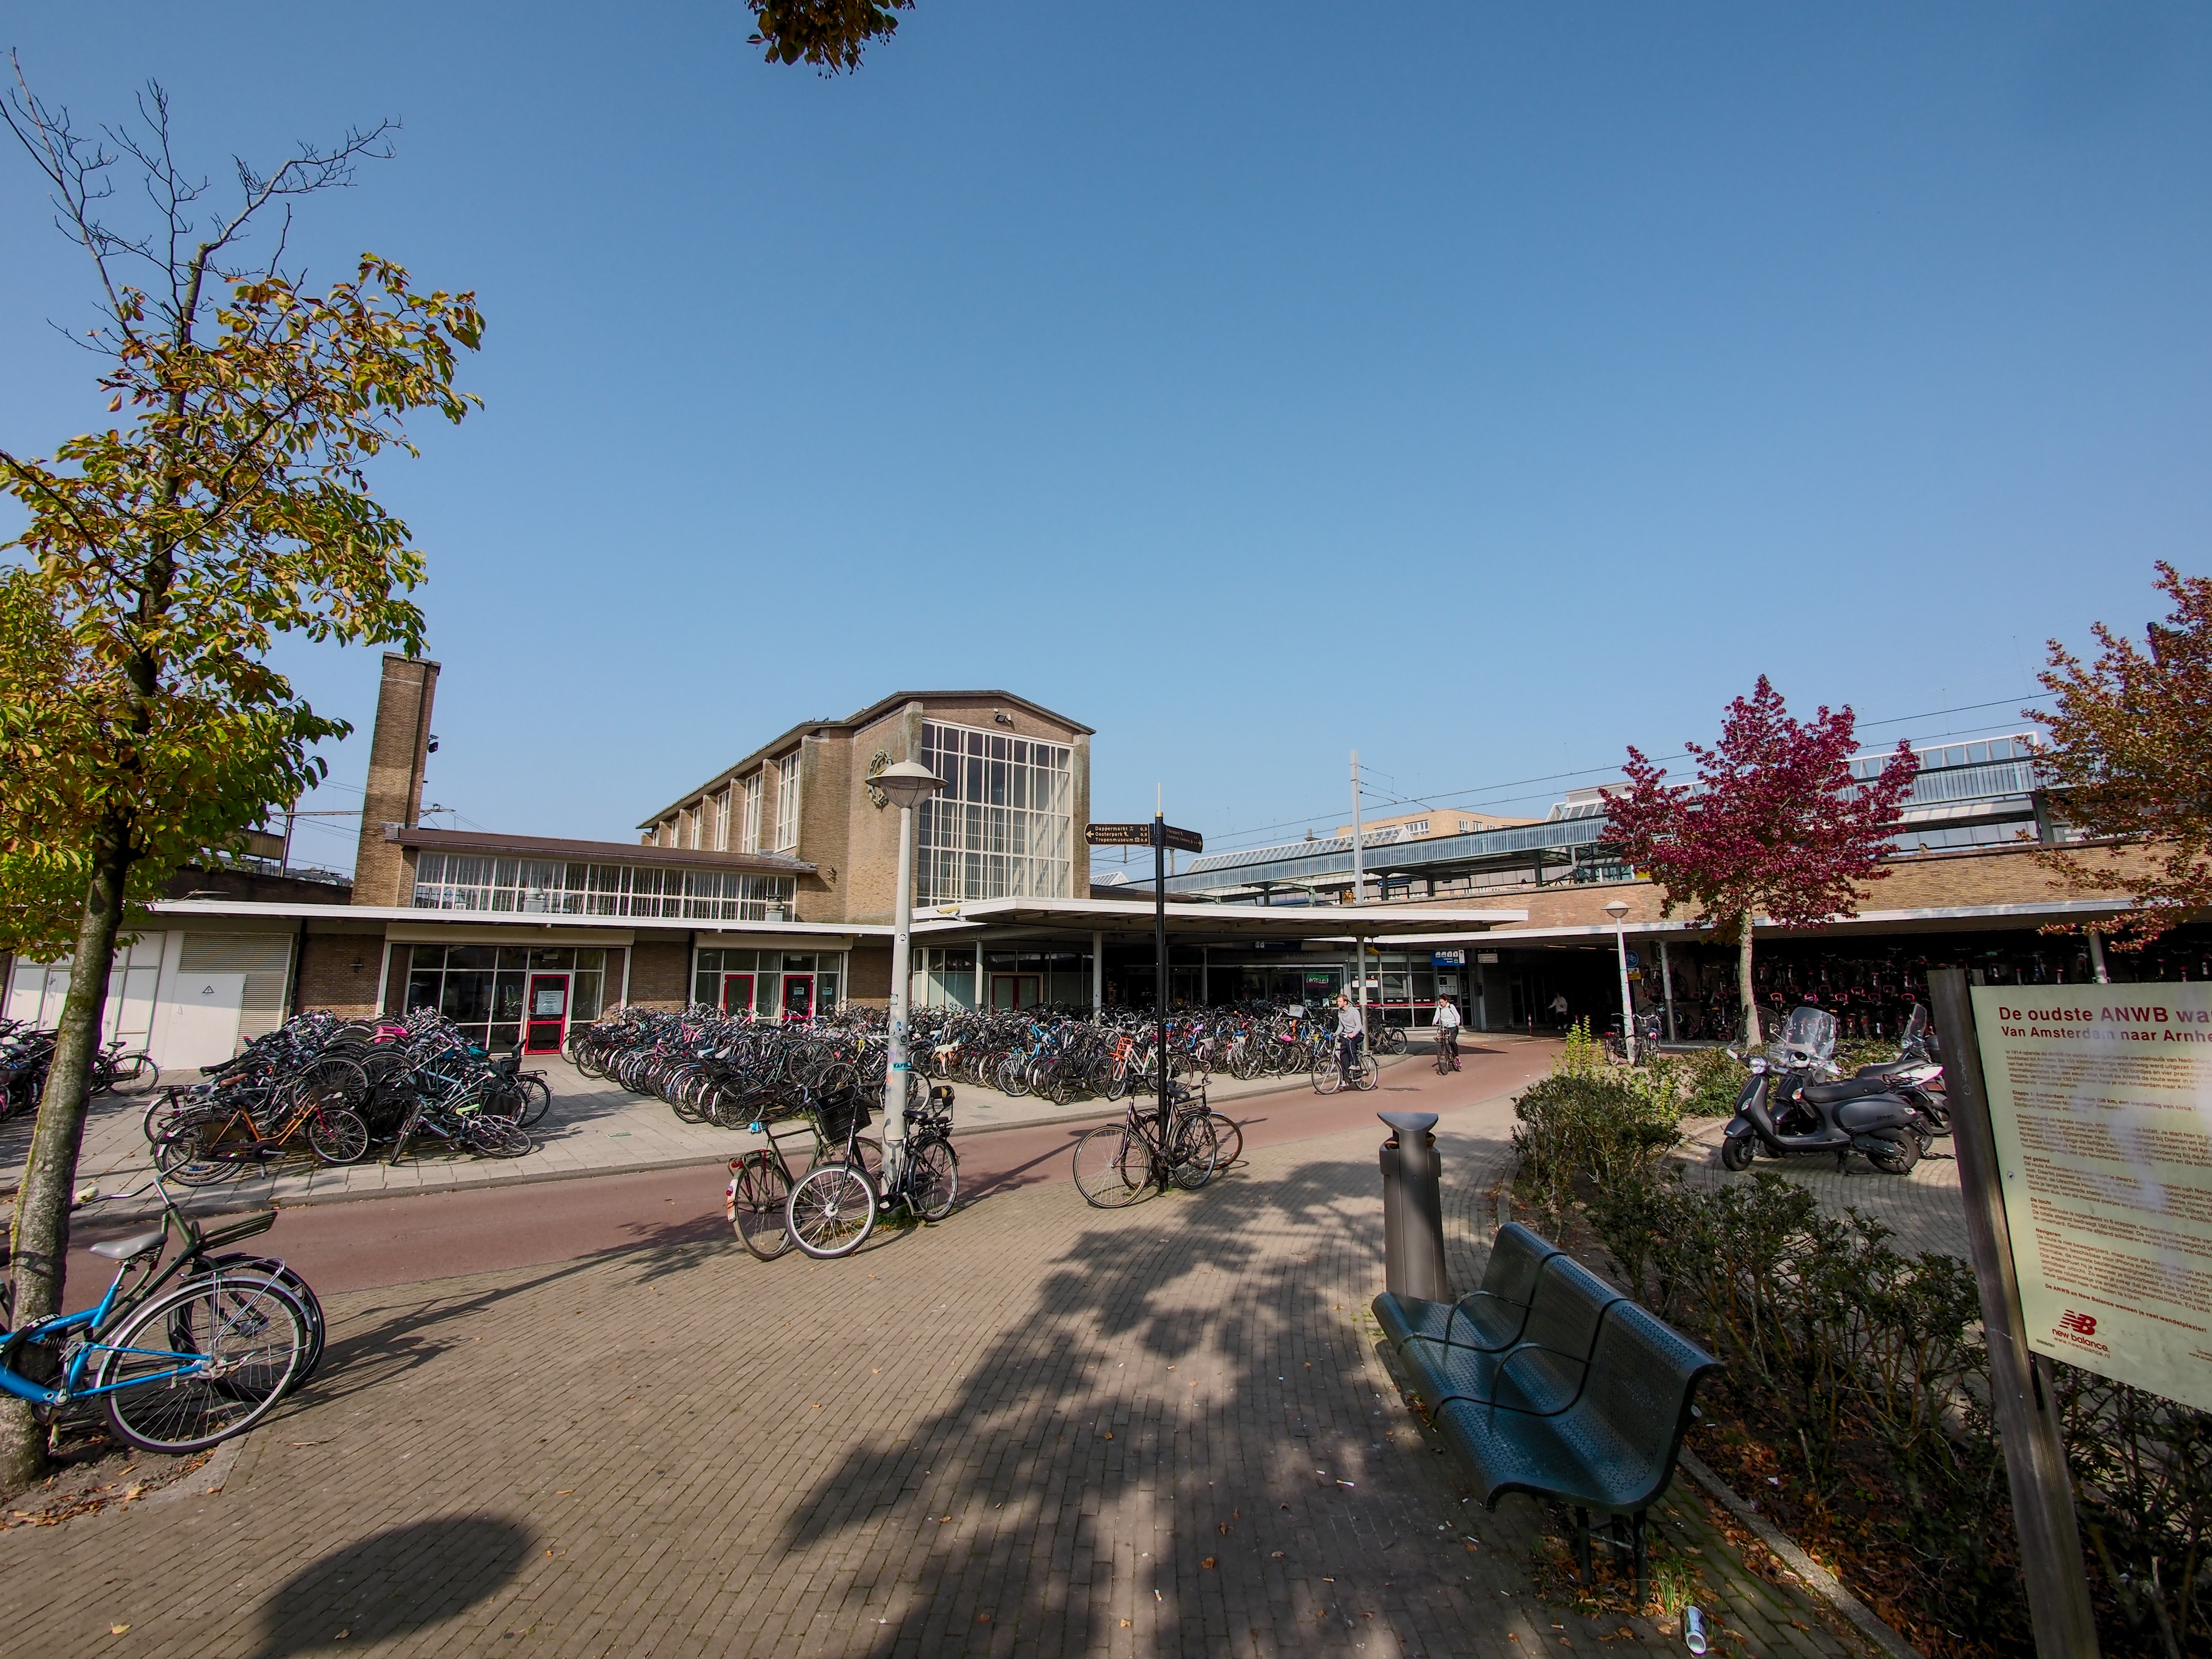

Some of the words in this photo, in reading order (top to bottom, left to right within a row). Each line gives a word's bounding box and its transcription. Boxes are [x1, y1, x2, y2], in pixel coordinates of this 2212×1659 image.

[1998, 1007, 2022, 1020] De
[2027, 1007, 2093, 1021] oudste
[2099, 1007, 2169, 1022] ANWB
[2175, 1010, 2212, 1022] wa
[2000, 1025, 2026, 1037] Van
[2029, 1026, 2115, 1039] Amsterdam
[2120, 1031, 2157, 1041] naar
[2035, 1227, 2061, 1237] Navigeren
[2074, 1213, 2102, 1222] opgedeeld
[2181, 1234, 2201, 1242] lengte
[2069, 1248, 2101, 1259] beschikbaar
[2143, 1265, 2167, 1275] Android
[2099, 1286, 2116, 1295] heden
[2176, 1286, 2192, 1295] buurt
[2193, 1291, 2210, 1299] komt
[2052, 1286, 2070, 1294] ANWB
[2091, 1297, 2114, 1307] Balance
[2115, 1304, 2138, 1313] wensen
[2159, 1316, 2207, 1333] wandelplezier!
[2184, 1302, 2196, 1310] Erg
[2058, 1309, 2097, 1335] NB
[2051, 1328, 2069, 1339] new
[2053, 1336, 2111, 1359] www.newbalance.nl
